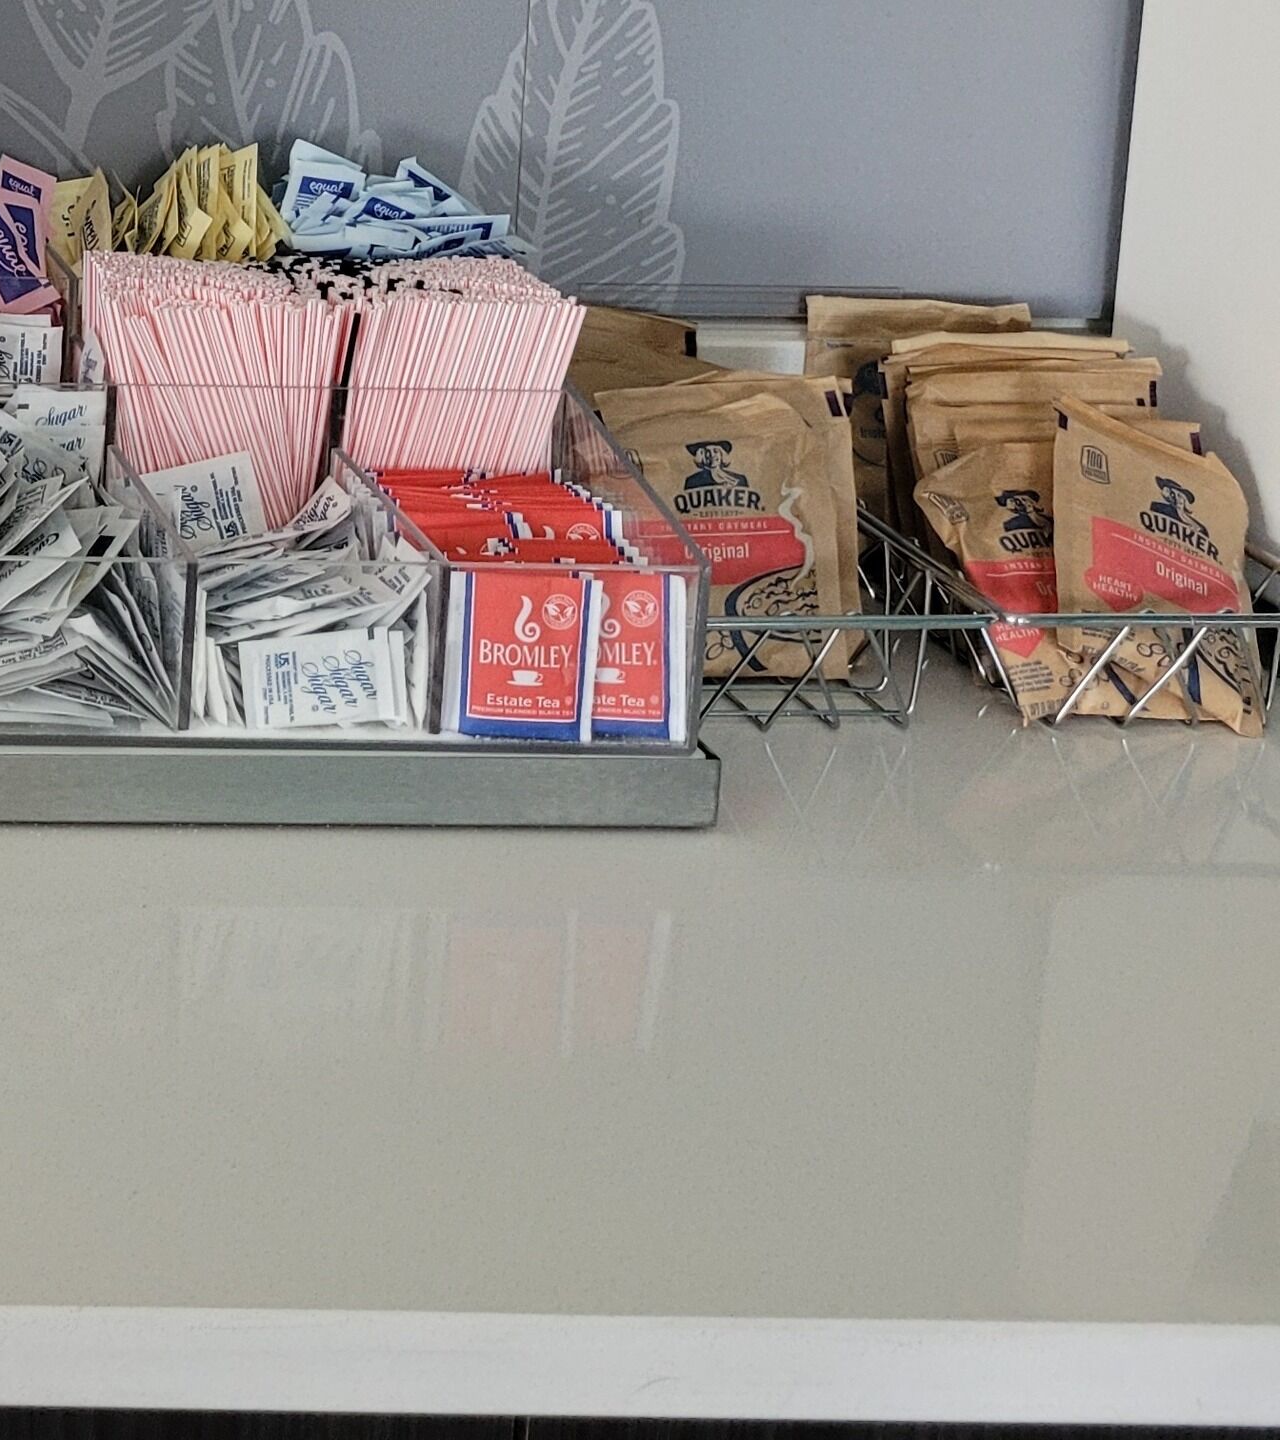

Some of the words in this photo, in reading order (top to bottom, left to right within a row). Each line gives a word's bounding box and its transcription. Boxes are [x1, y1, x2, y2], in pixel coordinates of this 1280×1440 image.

[8, 178, 37, 196] equal
[309, 180, 346, 195] equal
[36, 404, 87, 426] Sugar
[1087, 449, 1103, 470] 100
[673, 488, 762, 514] QUAKER
[1139, 511, 1220, 561] QUAKER
[1099, 575, 1132, 592] HEART
[1155, 560, 1208, 596] Original
[1093, 582, 1138, 602] HEALTHY
[479, 639, 573, 668] BROMLEY
[321, 655, 358, 708] Sugar
[343, 649, 378, 700] Sugar
[301, 662, 337, 714] Sugar
[487, 693, 532, 707] Estate
[536, 695, 560, 708] Tea
[620, 695, 645, 707] Tea
